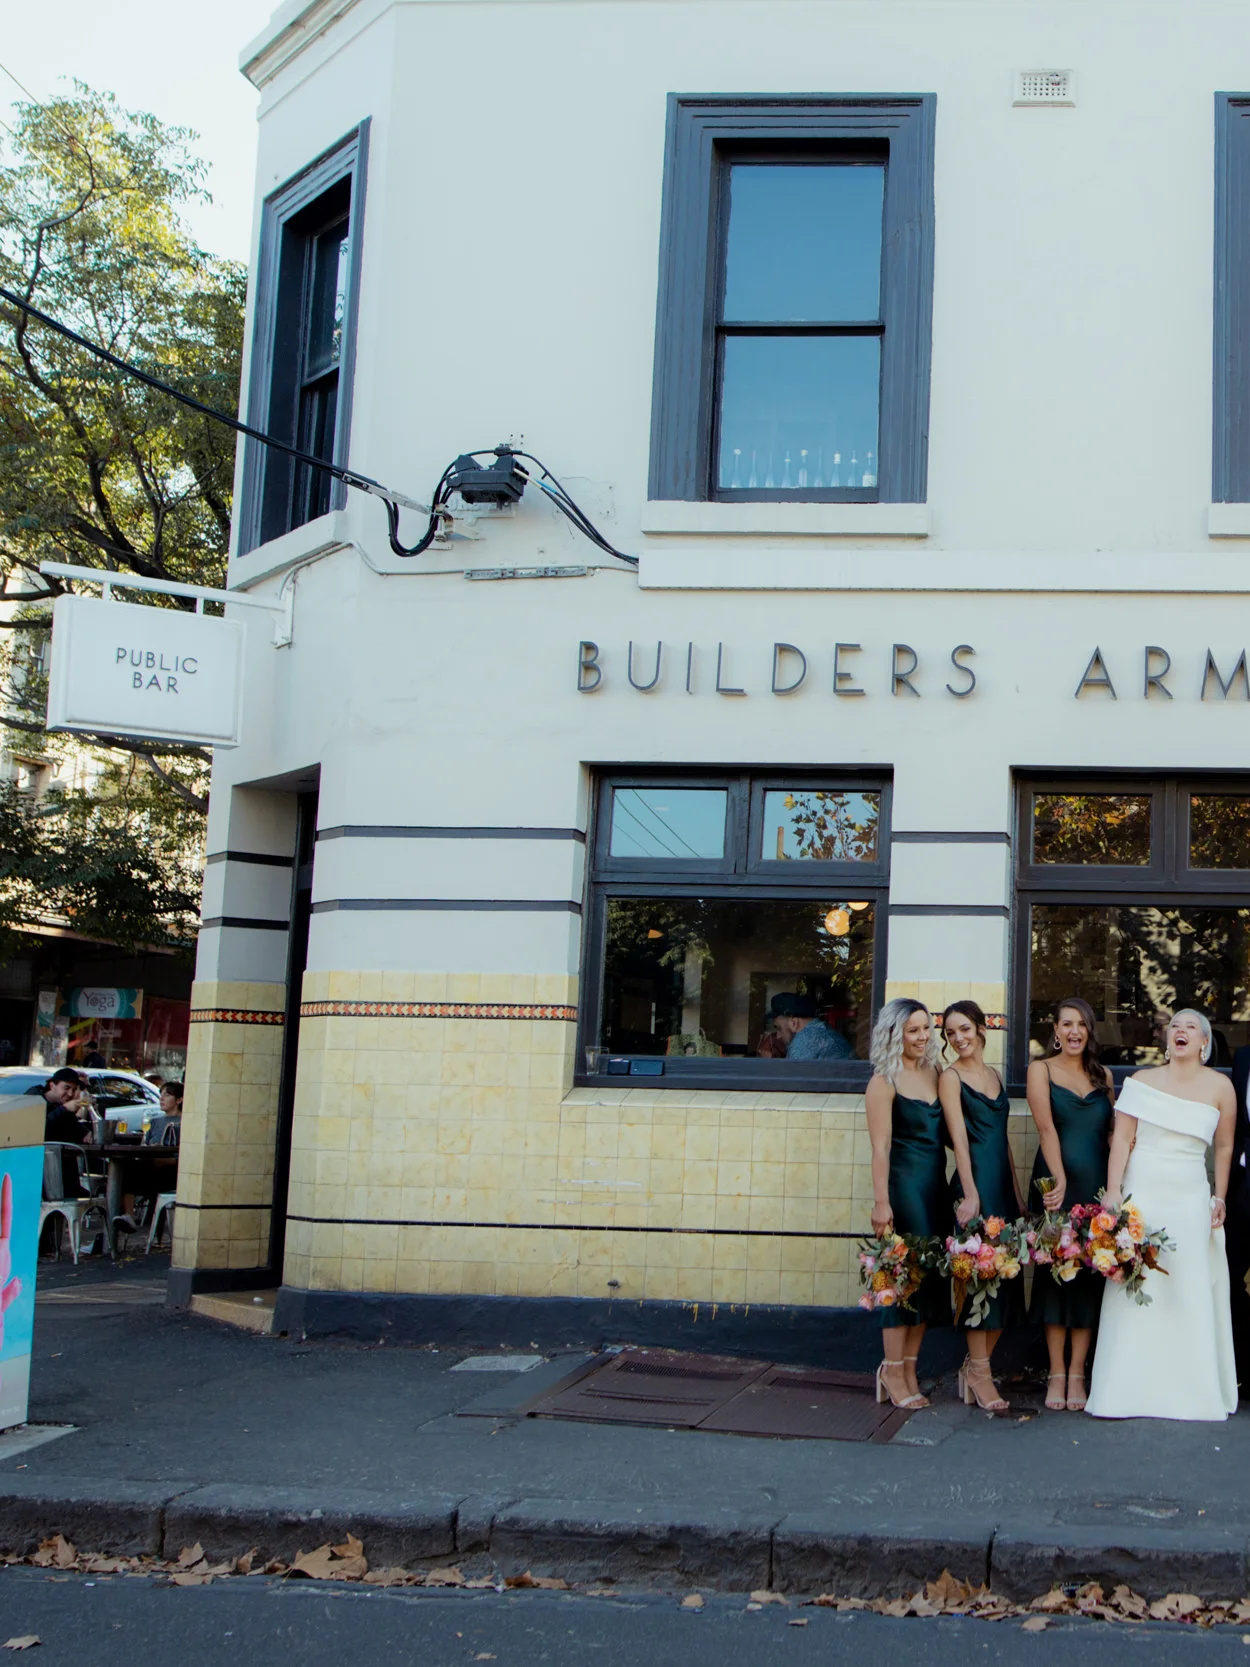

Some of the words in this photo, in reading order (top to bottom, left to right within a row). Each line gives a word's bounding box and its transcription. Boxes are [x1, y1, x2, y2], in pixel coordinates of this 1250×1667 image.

[115, 647, 199, 674] PUBLIC
[577, 641, 976, 700] BUILDERS
[132, 671, 179, 694] BAR
[83, 991, 115, 1012] Yoga
